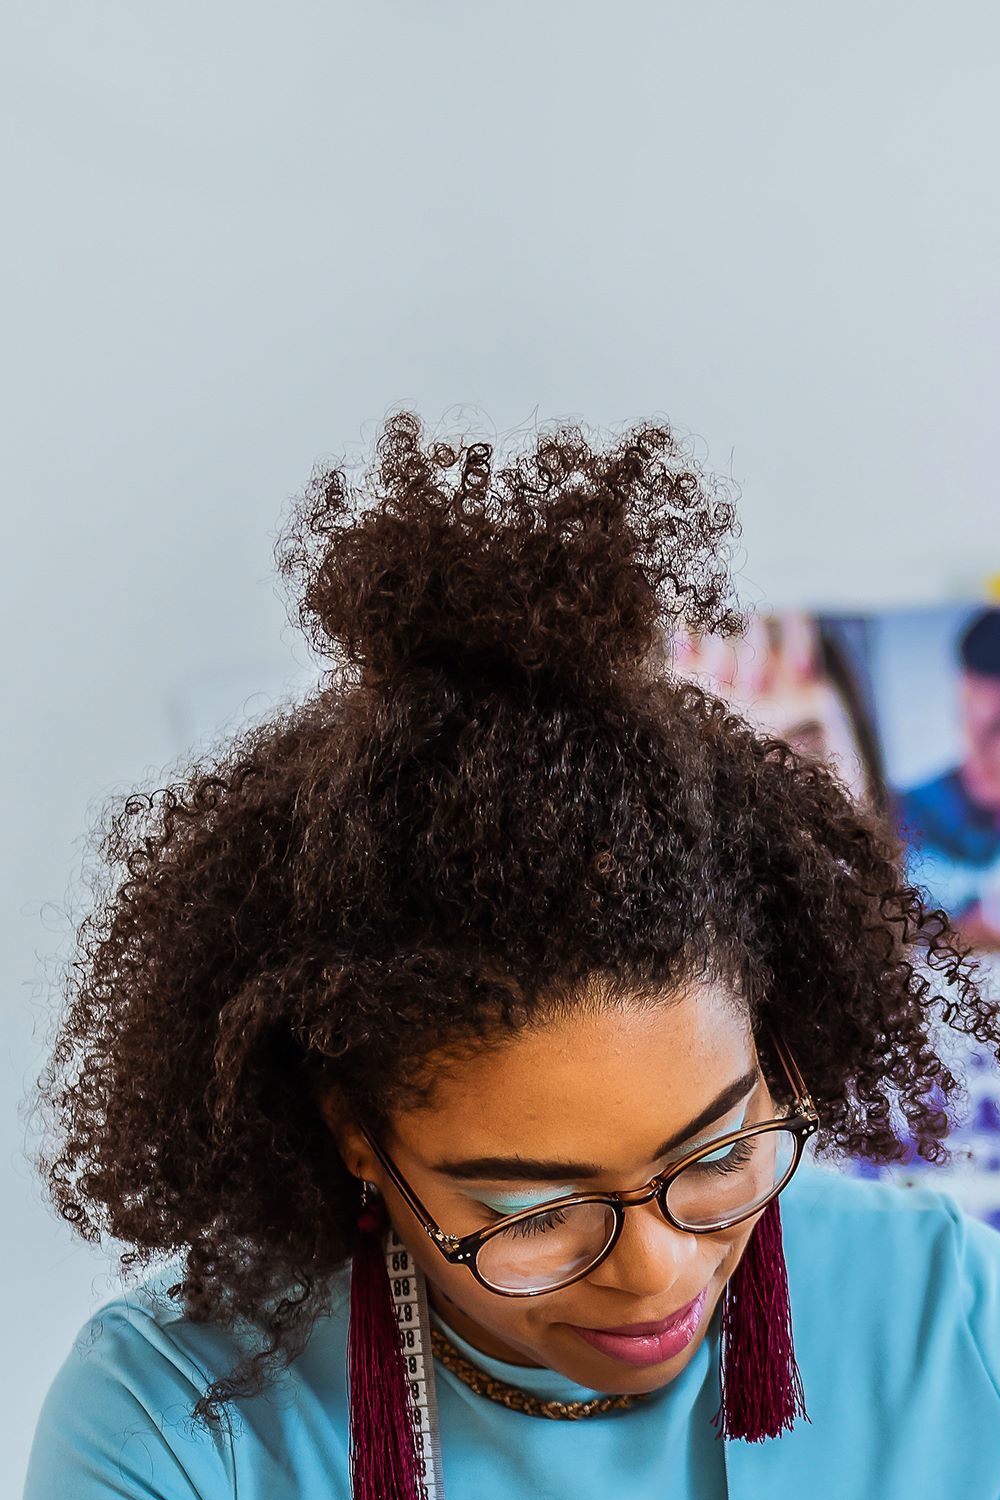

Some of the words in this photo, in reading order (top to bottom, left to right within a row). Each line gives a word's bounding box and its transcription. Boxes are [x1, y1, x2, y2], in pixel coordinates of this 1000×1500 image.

[392, 1252, 408, 1271] 89
[394, 1278, 410, 1297] 88
[397, 1304, 413, 1323] 87
